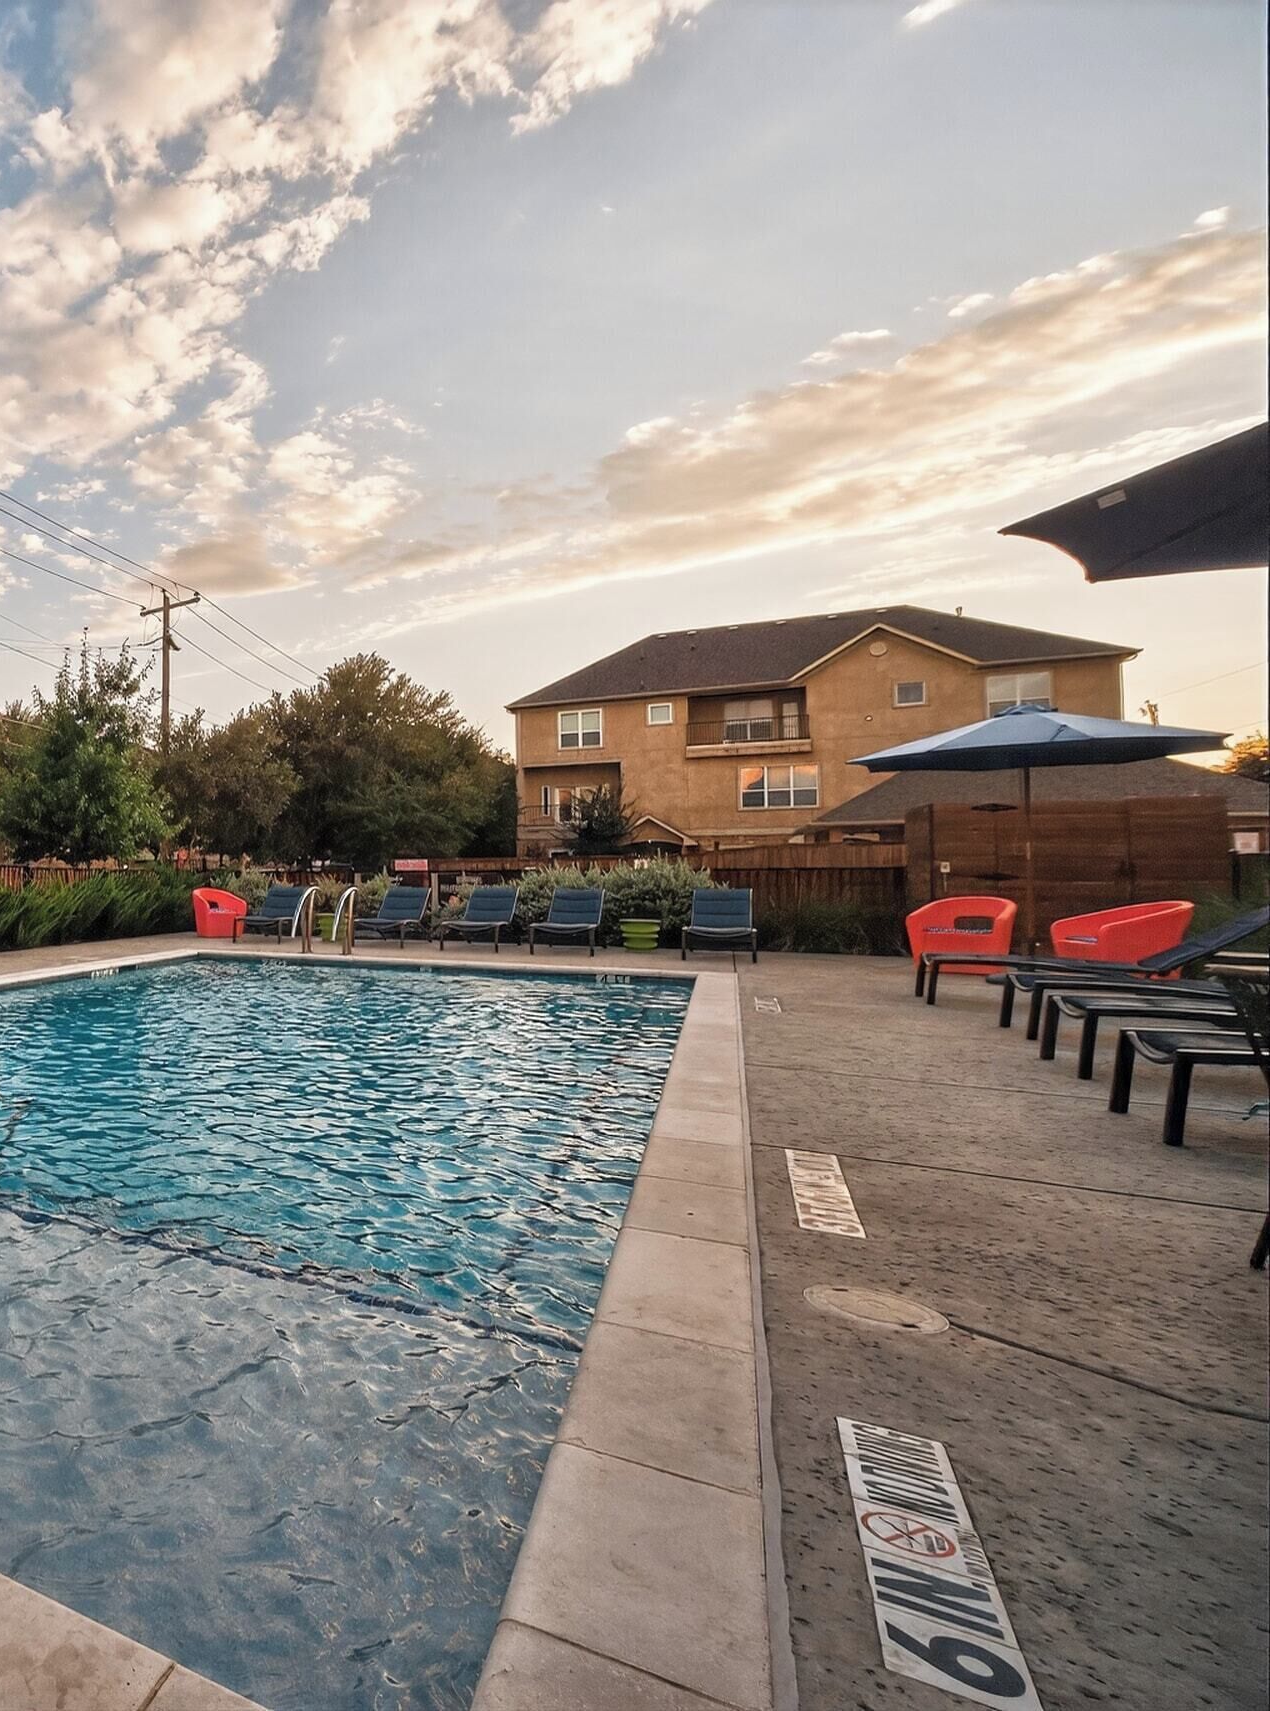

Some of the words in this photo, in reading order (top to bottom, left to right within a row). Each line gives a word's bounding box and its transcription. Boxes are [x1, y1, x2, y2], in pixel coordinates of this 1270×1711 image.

[851, 1422, 950, 1497] DIVING
[862, 1479, 961, 1525] NO
[884, 1619, 1027, 1698] 6
